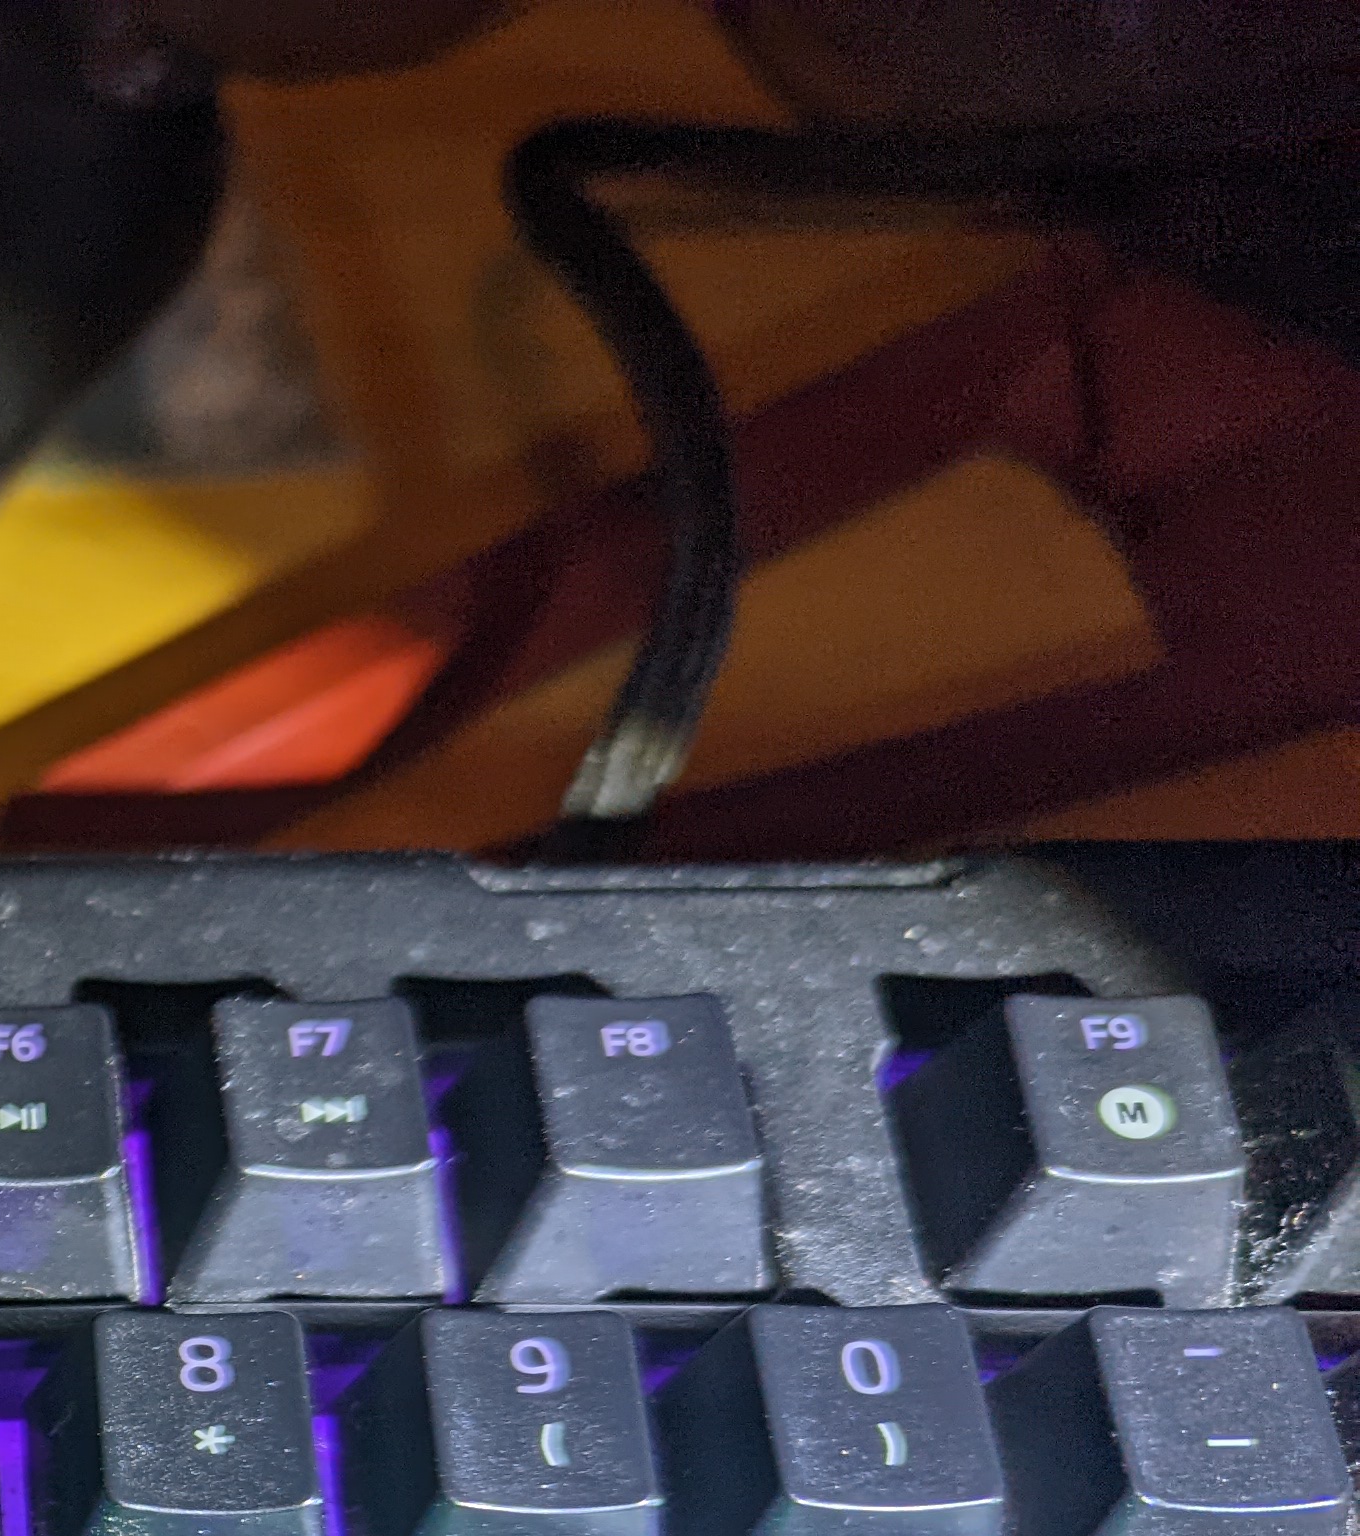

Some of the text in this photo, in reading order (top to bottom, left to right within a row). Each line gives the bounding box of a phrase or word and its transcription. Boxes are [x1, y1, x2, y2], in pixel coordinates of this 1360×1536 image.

[287, 1019, 353, 1058] F7
[600, 1020, 671, 1057] F8
[1080, 1014, 1148, 1050] F9
[1116, 1102, 1148, 1123] M
[179, 1336, 235, 1392] 8
[509, 1337, 570, 1394] 9
